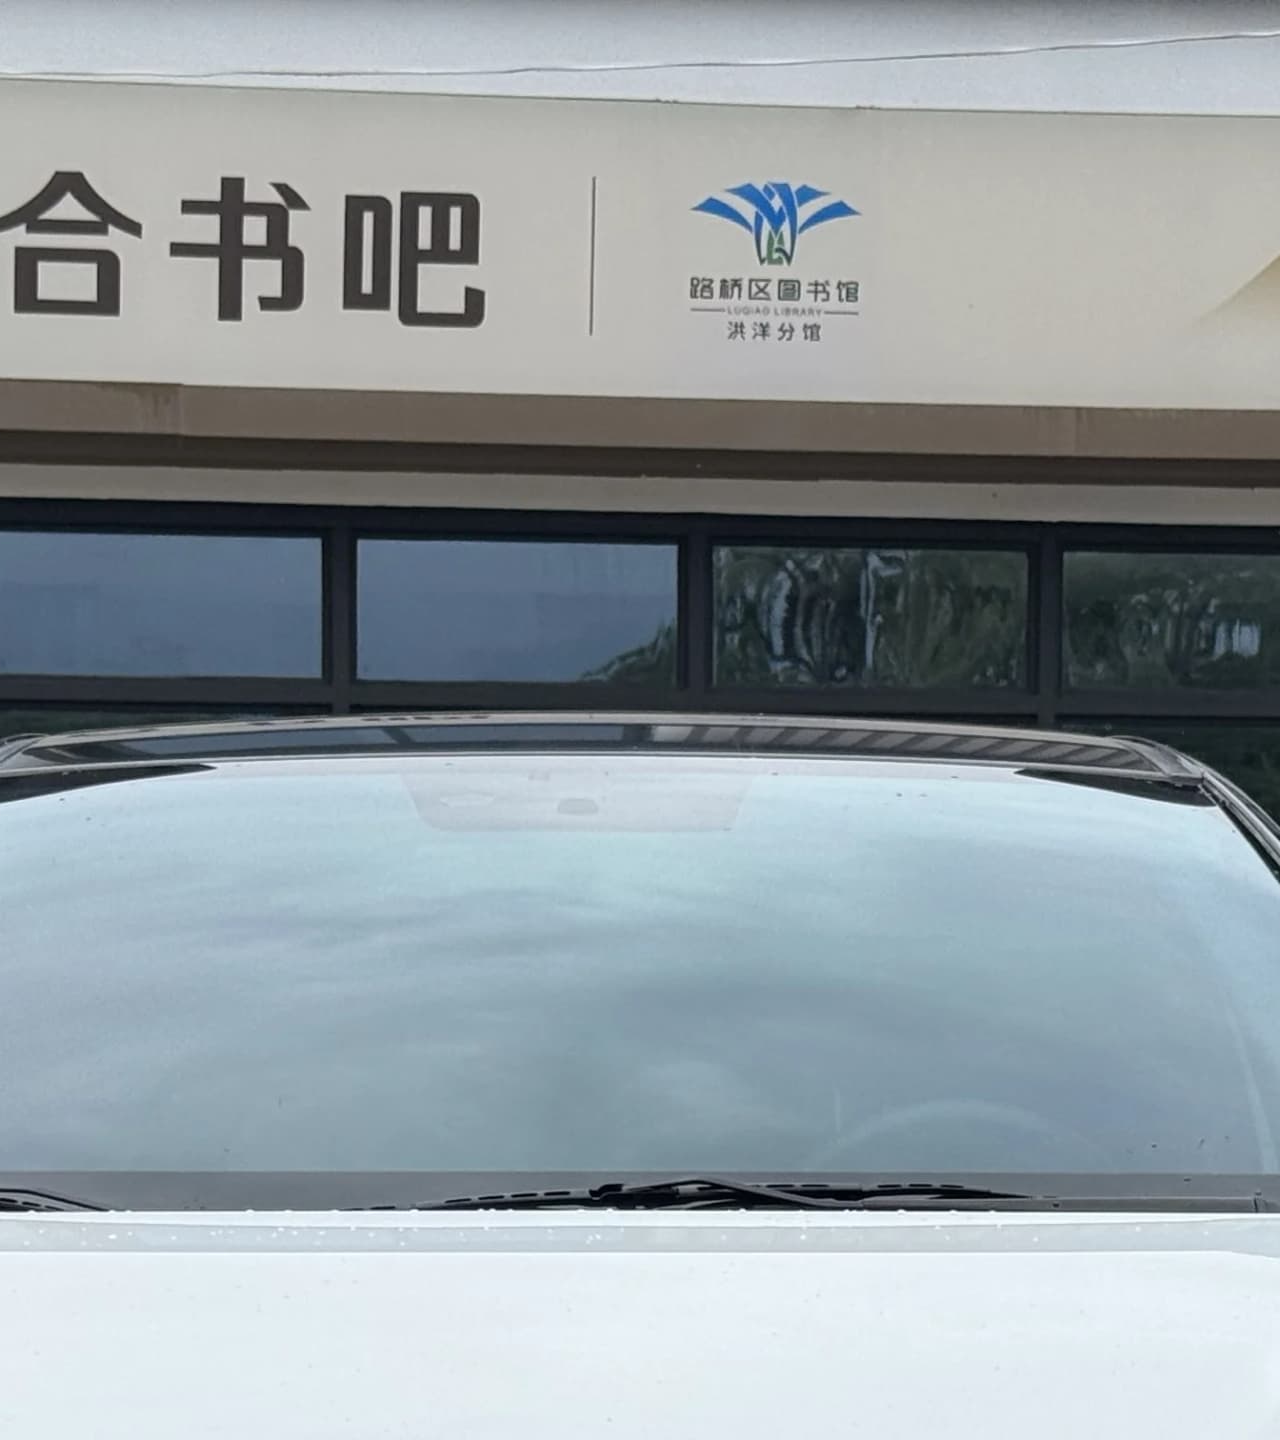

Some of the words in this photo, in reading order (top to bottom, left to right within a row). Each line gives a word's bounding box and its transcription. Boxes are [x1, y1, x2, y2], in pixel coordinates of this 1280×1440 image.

[774, 307, 822, 317] LIBRARY
[727, 320, 822, 342] 洪洋分馆
